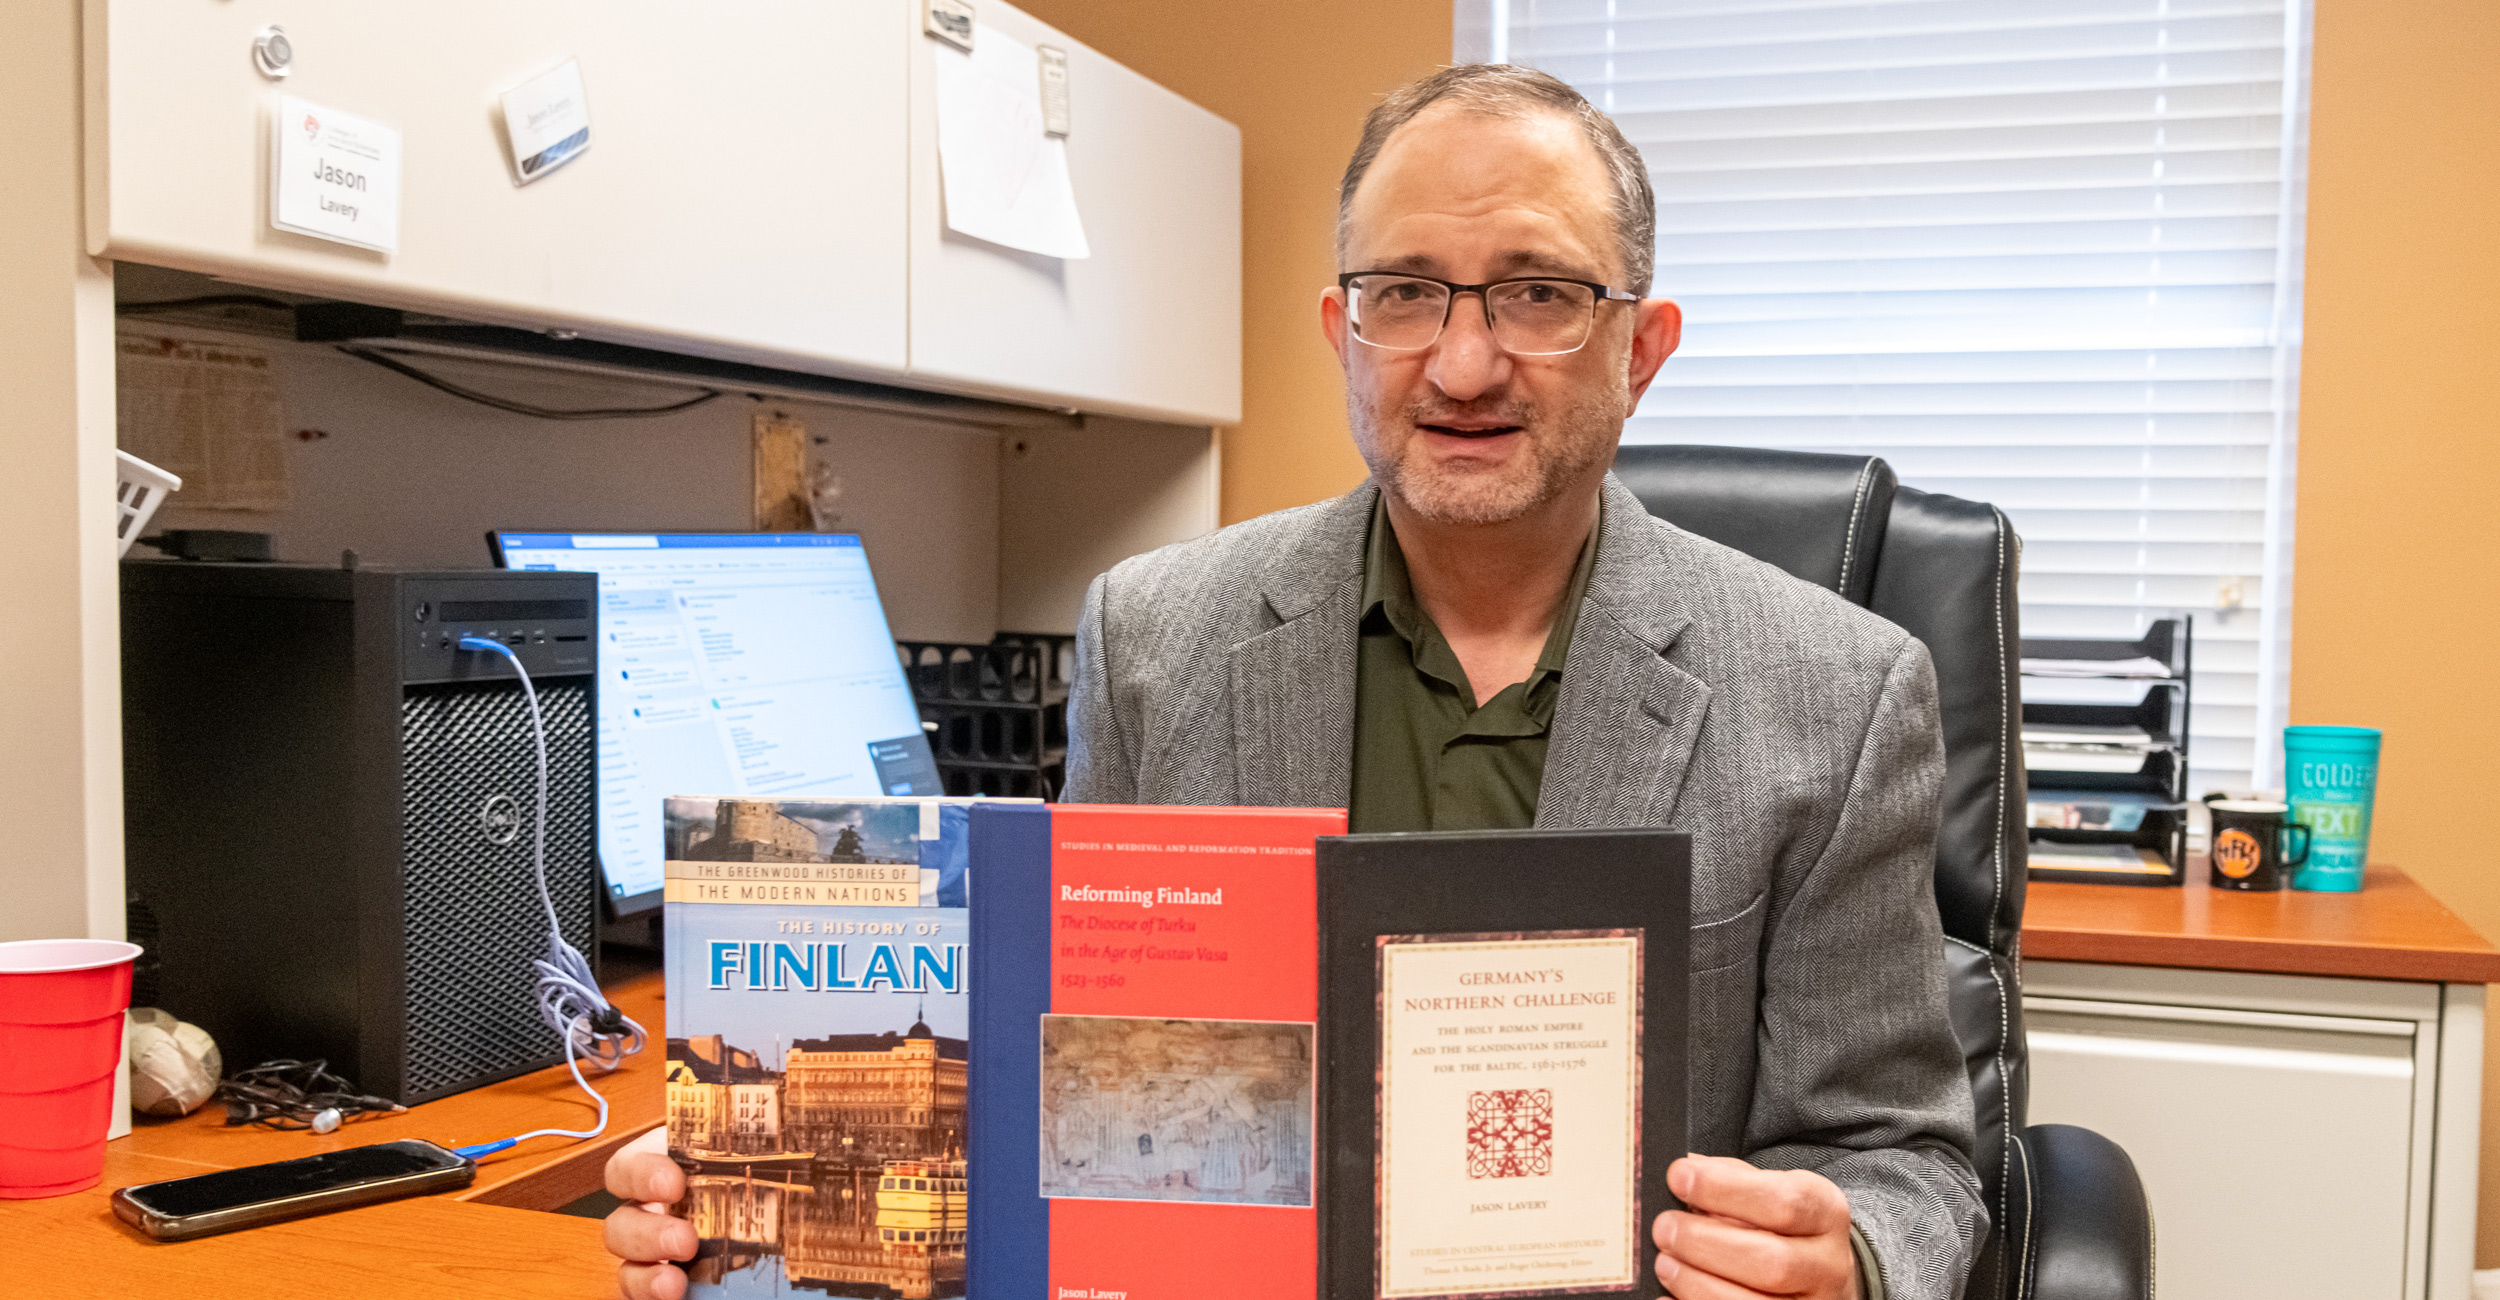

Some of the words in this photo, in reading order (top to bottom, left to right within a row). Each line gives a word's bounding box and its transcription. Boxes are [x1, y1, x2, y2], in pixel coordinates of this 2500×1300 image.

[313, 157, 367, 192] Jason
[320, 194, 360, 222] Lavery
[2302, 806, 2359, 835] TEXT
[1060, 841, 1100, 850] STUDIES
[1102, 842, 1114, 851] IN
[1115, 843, 1162, 852] MEDIEVAL
[1165, 844, 1187, 853] AND
[1188, 845, 1257, 854] REFORMATION
[1260, 846, 1313, 855] TRADITION
[698, 865, 721, 877] THE
[728, 865, 809, 879] GREENWOOD
[816, 867, 885, 880] HISTORIES
[892, 868, 907, 880] OF
[698, 884, 730, 899] THE
[741, 885, 816, 901] MODERN
[827, 887, 907, 902] NATIONS
[1060, 885, 1153, 908] Reforming
[1156, 887, 1223, 905] Finland
[777, 920, 814, 935] THE
[822, 921, 908, 936] HISTORY
[915, 922, 942, 937] OF
[1060, 914, 1085, 930] The
[1087, 915, 1138, 931] Diocese
[1140, 916, 1155, 936] of
[1157, 917, 1197, 933] Turku
[1061, 942, 1075, 958] in
[1078, 944, 1099, 958] the
[1102, 945, 1127, 964] Age
[1129, 944, 1146, 964] of
[1146, 946, 1194, 961] Gustav
[1196, 947, 1228, 962] Vasa
[707, 940, 969, 994] FINLAN
[1459, 968, 1564, 986] GERMANY'S
[1405, 995, 1505, 1012] NORTHERN
[1513, 991, 1617, 1008] CHALLENGE
[1437, 1026, 1460, 1036] THE
[1464, 1025, 1494, 1035] HOLY
[1499, 1023, 1539, 1034] ROMAN
[1543, 1022, 1585, 1033] EMPIRE
[1411, 1046, 1436, 1056] AND
[1440, 1045, 1462, 1054] THE
[1466, 1042, 1549, 1053] SCANDINAVIAN
[1553, 1039, 1609, 1050] STRUGGLE
[1433, 1064, 1455, 1074] FOR
[1460, 1063, 1482, 1073] THE
[1486, 1060, 1528, 1072] BALTIC,
[1470, 1202, 1503, 1216] JASON
[1507, 1200, 1548, 1211] LAVERY
[1058, 1286, 1088, 1300] Jason
[1090, 1287, 1128, 1300] Lavery
